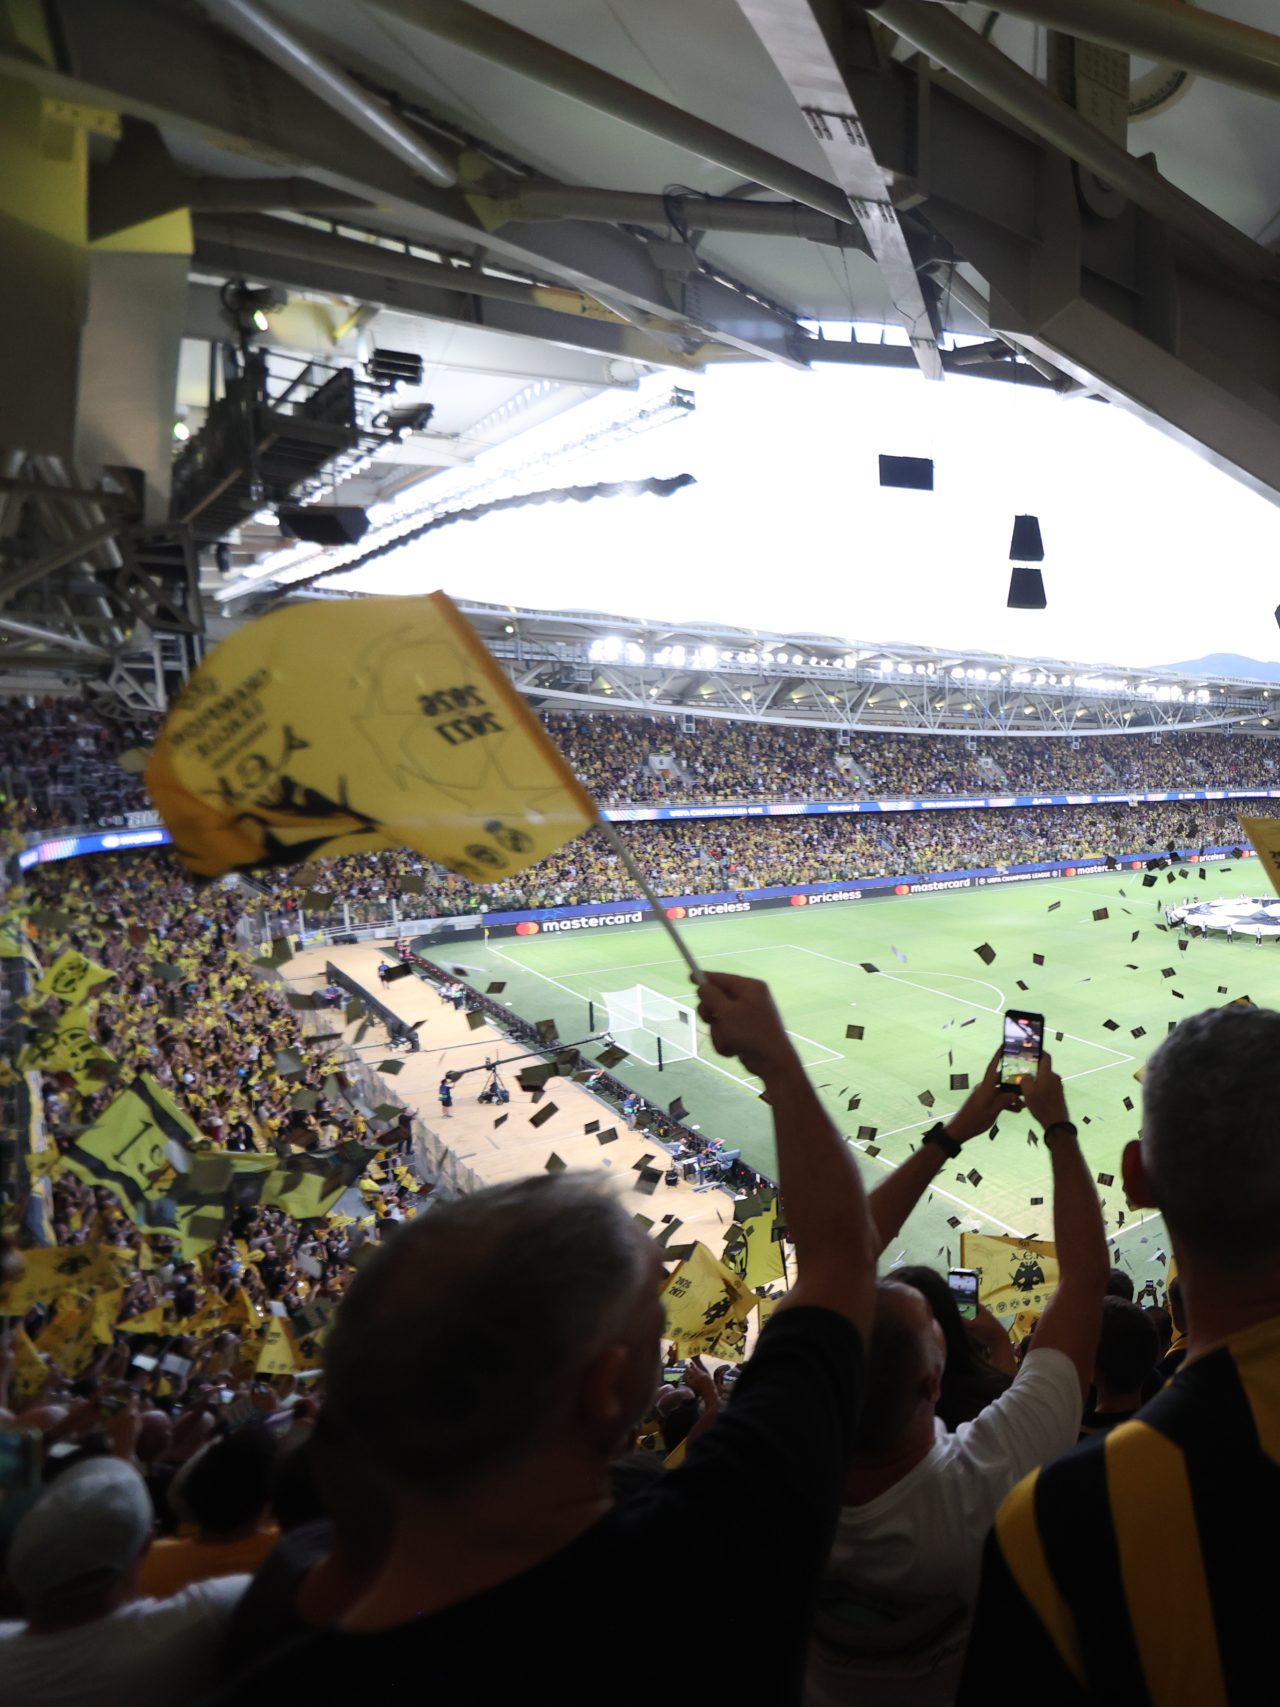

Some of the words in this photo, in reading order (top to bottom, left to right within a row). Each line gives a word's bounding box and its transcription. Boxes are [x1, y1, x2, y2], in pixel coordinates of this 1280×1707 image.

[910, 878, 970, 893] mastercard
[808, 890, 862, 905] priceless
[688, 901, 751, 918] priceless
[542, 911, 643, 932] mastercard
